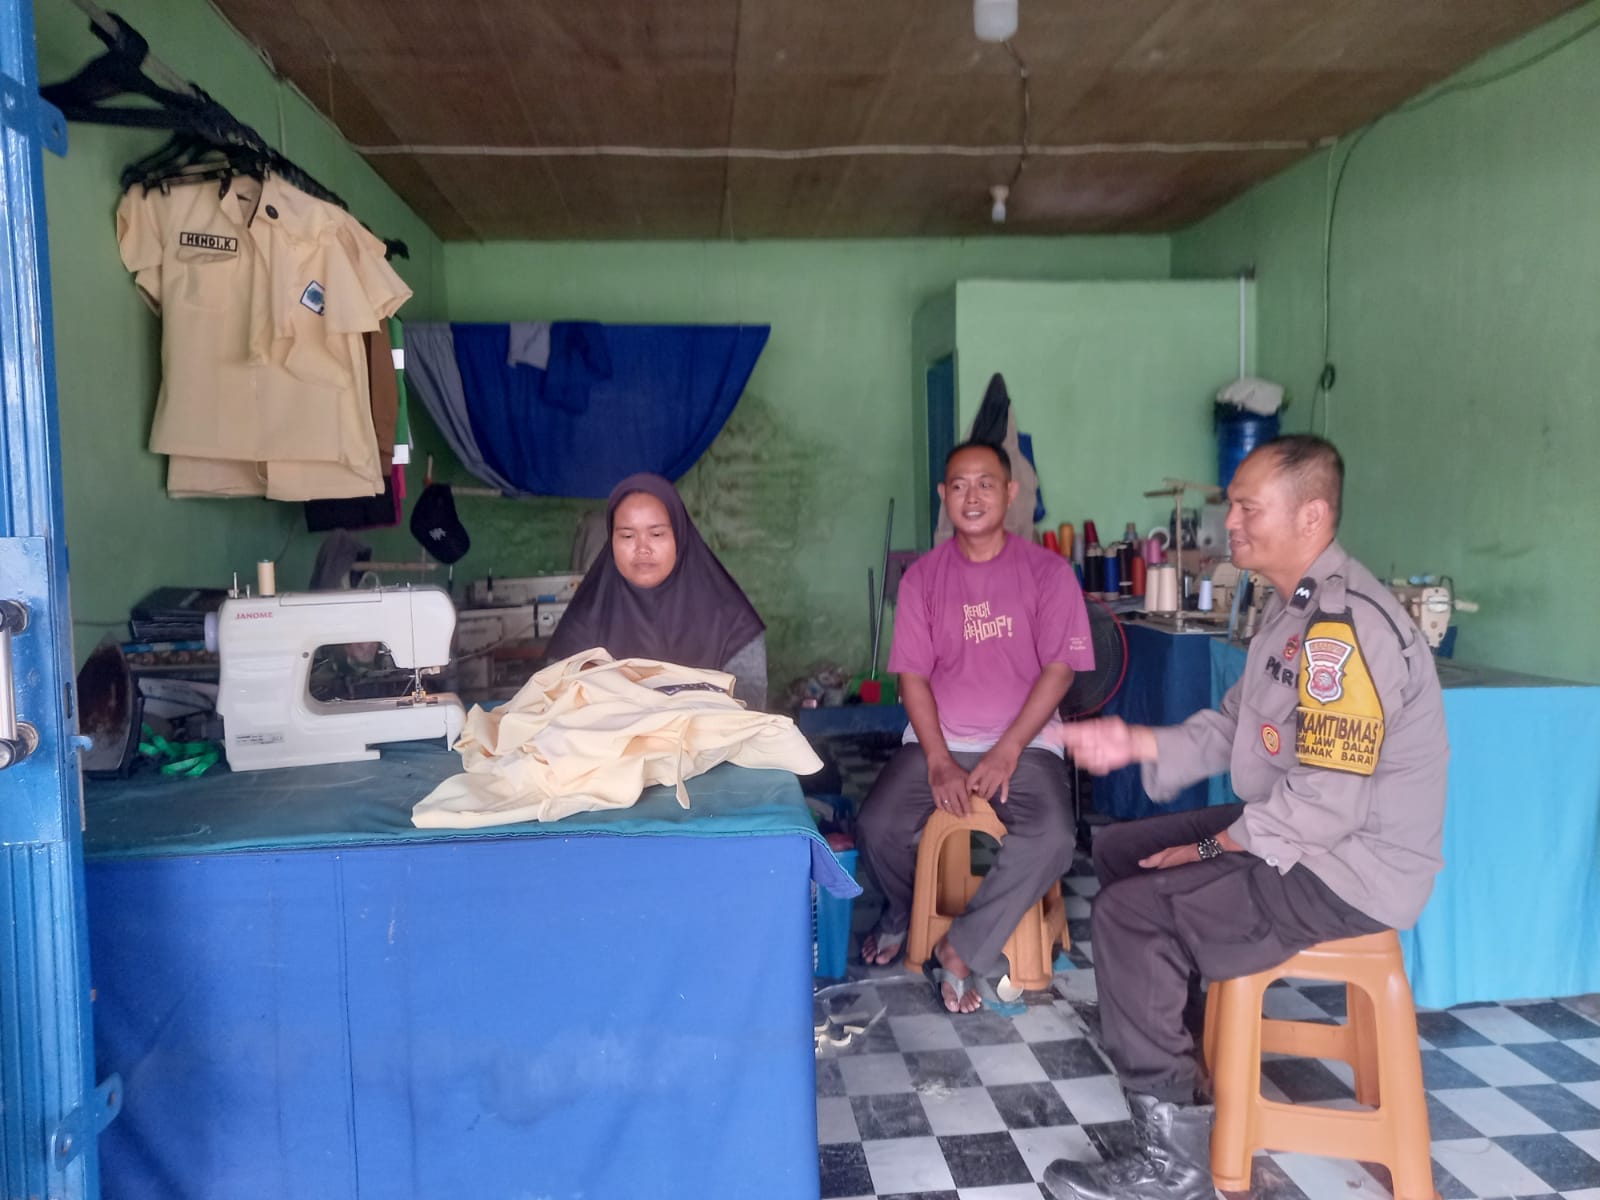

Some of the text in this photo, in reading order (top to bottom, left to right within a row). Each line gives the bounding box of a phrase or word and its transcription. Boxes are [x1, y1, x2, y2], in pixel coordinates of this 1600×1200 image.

[235, 611, 273, 620] JANOME
[963, 600, 991, 621] REACH
[1312, 735, 1336, 749] JAWI
